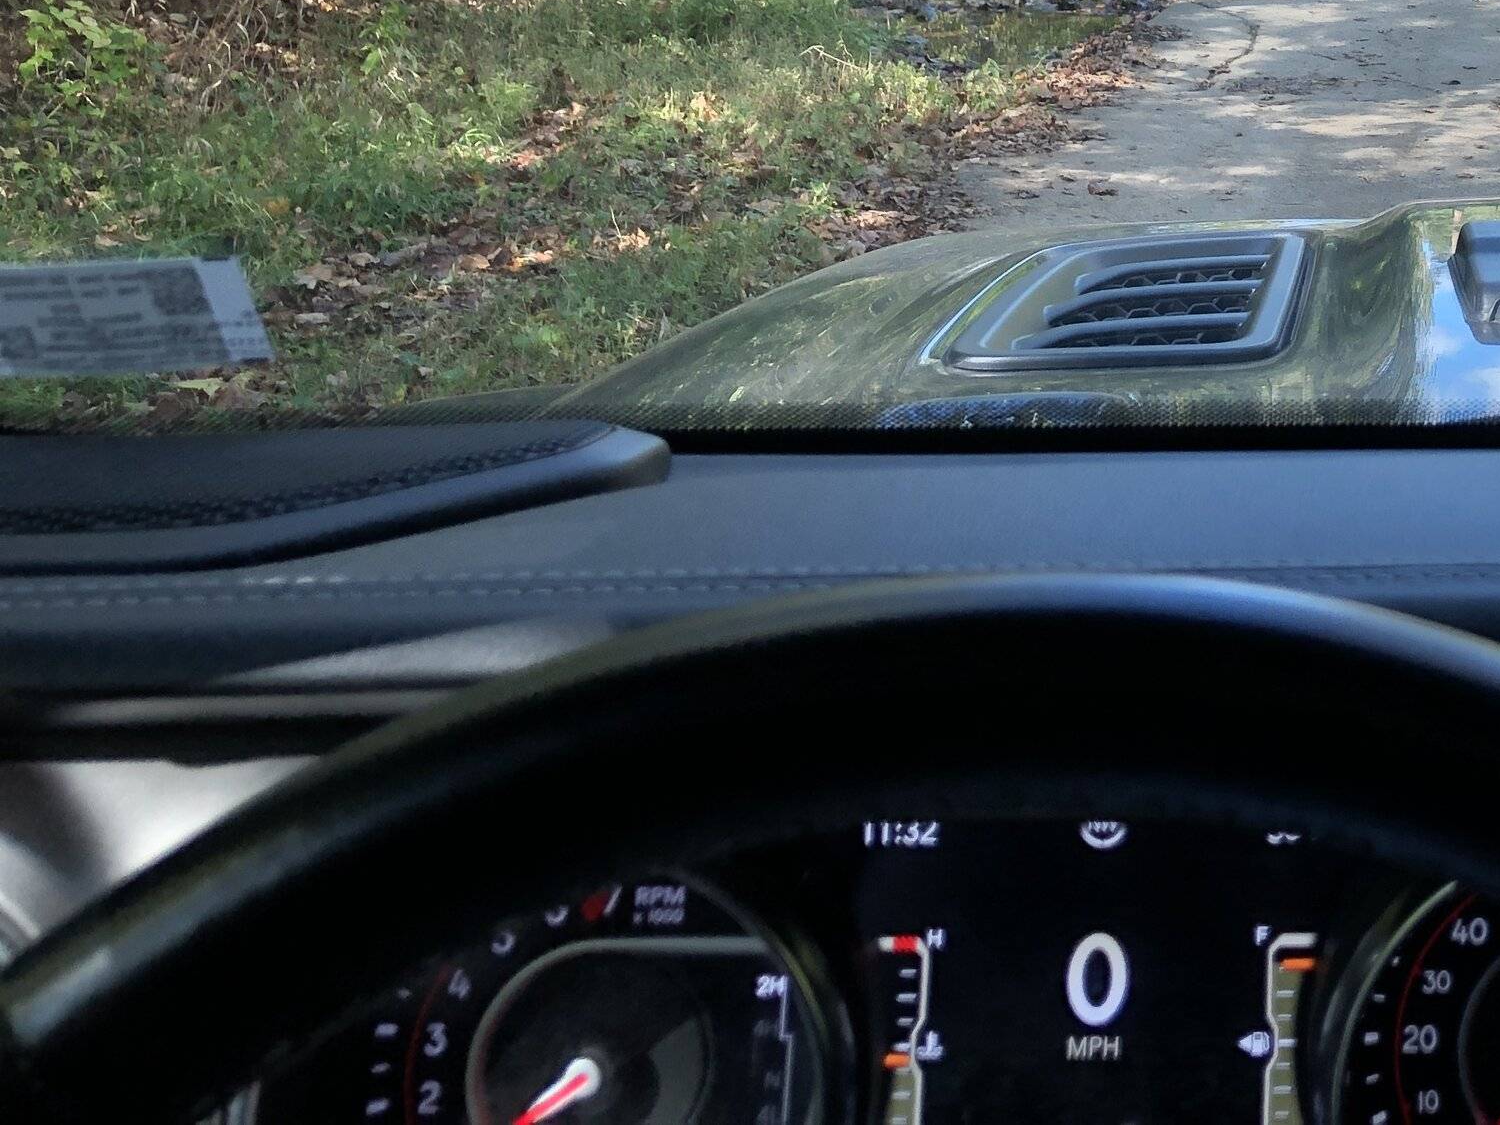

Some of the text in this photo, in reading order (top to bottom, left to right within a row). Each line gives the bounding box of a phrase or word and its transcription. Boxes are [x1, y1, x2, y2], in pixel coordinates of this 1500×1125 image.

[863, 821, 939, 847] 11:32
[634, 885, 687, 906] RPM
[927, 928, 945, 949] H
[1254, 925, 1271, 945] F
[1450, 917, 1489, 946] 40
[447, 968, 472, 1000] 4
[1065, 932, 1130, 1027] 0
[1422, 969, 1452, 995] 30
[423, 1022, 448, 1057] 3
[1066, 1035, 1120, 1060] MPH
[1402, 1024, 1439, 1054] 20
[417, 1079, 442, 1115] 2
[1417, 1089, 1440, 1114] 10
